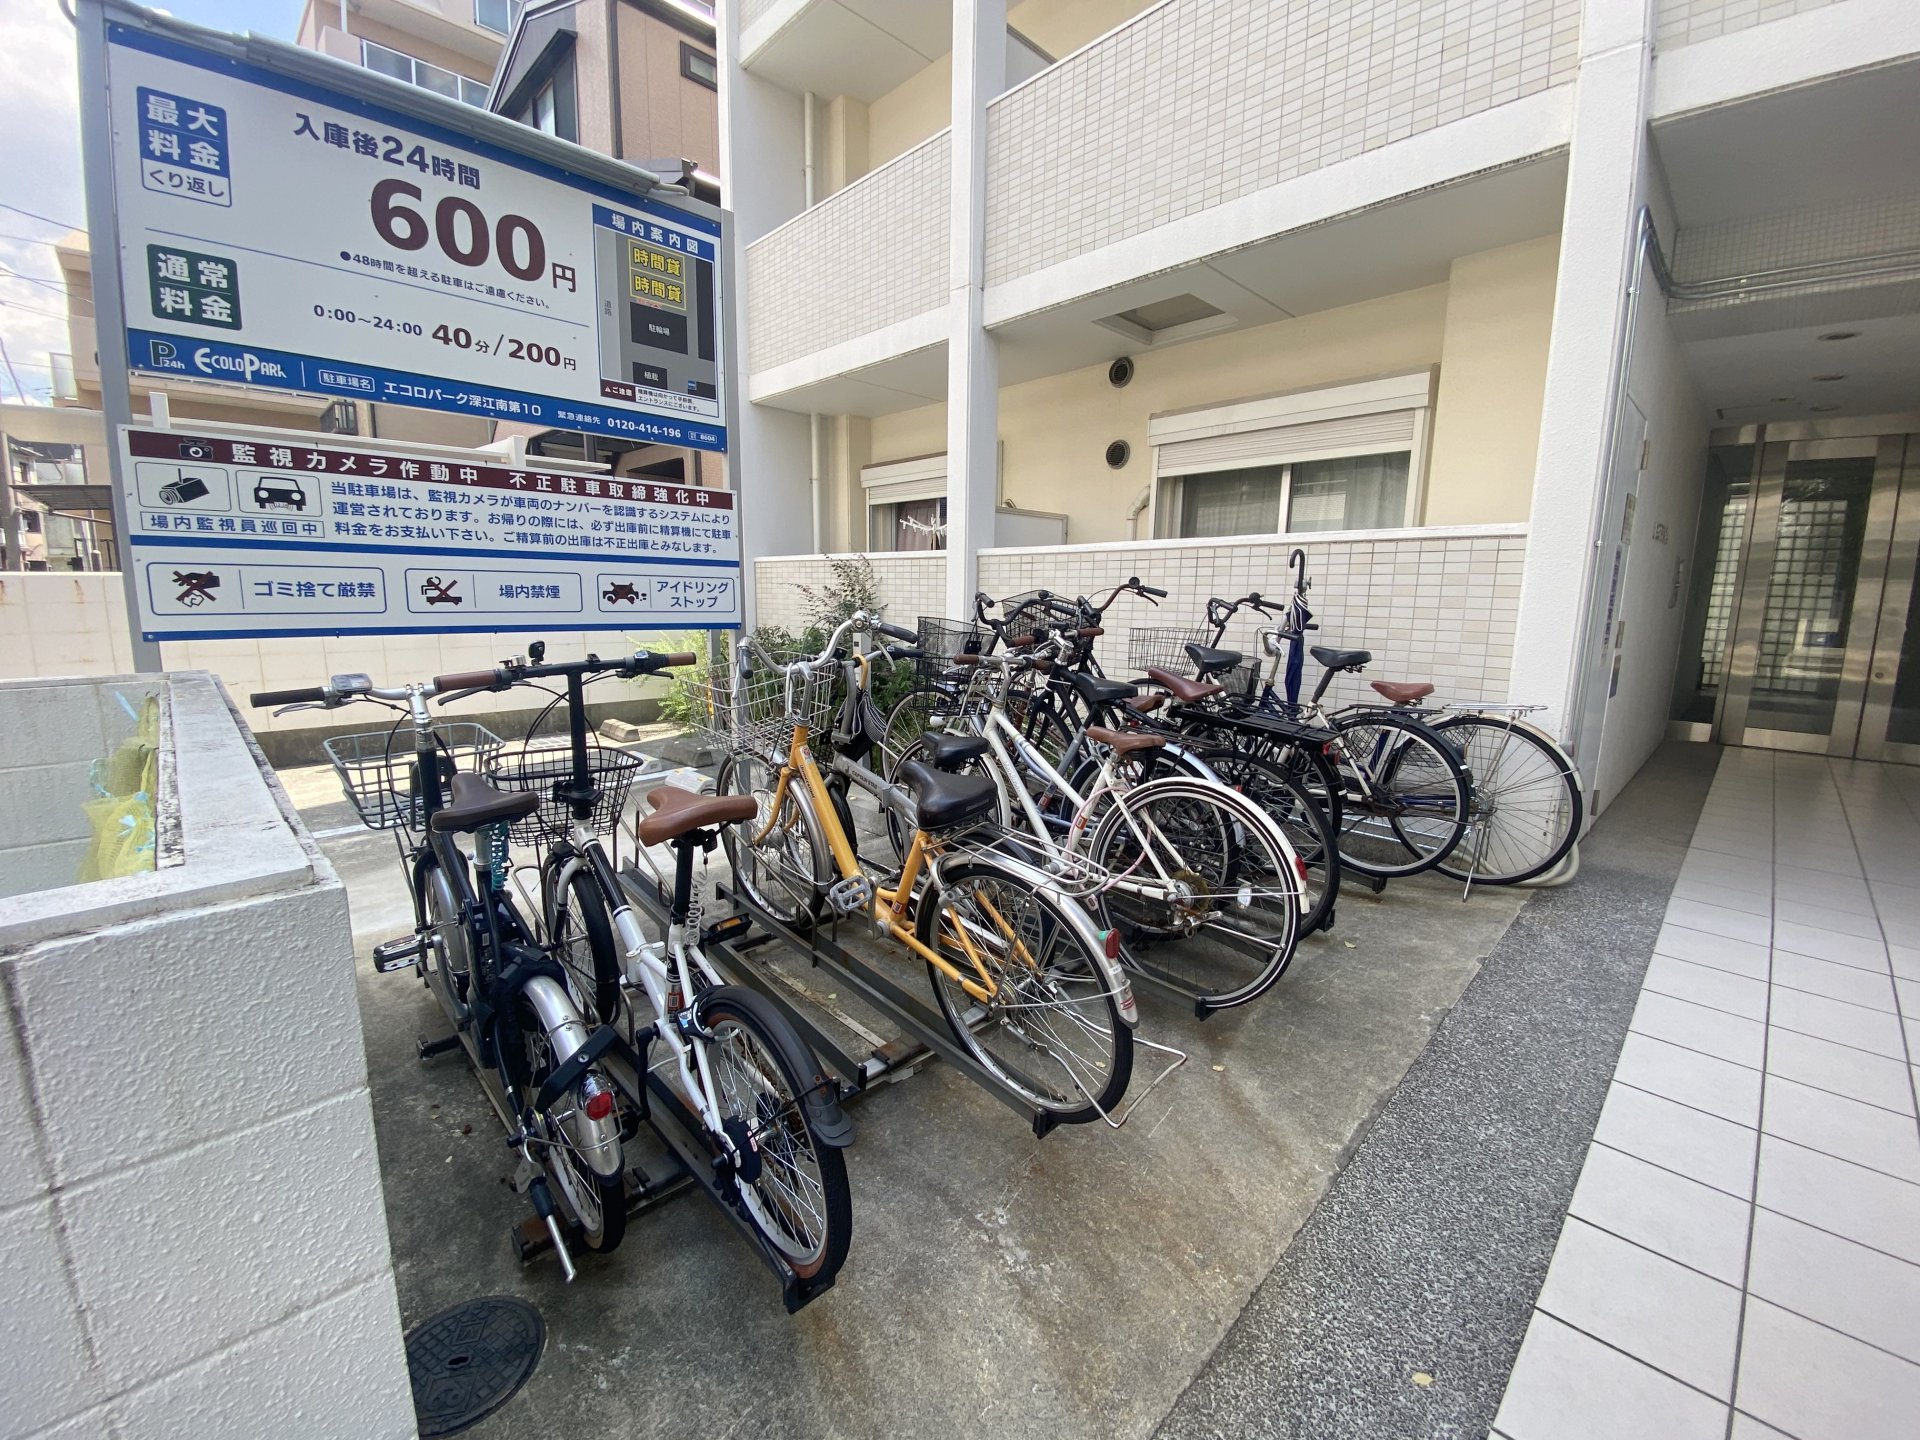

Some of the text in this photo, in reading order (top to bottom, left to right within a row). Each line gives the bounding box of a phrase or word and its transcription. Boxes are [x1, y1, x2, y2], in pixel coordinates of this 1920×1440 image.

[147, 94, 218, 136] 最大
[149, 129, 221, 171] 料金
[293, 112, 480, 190] 入庫後24時間
[150, 169, 224, 198] くり返し
[370, 179, 577, 293] 600円
[611, 213, 698, 254] 場内案内図
[157, 252, 228, 289] 通常
[633, 247, 681, 277] 時間貸
[160, 286, 232, 323] 料金
[634, 275, 682, 303] 時間貸
[321, 371, 373, 390] 駐車場名
[384, 381, 542, 417] エコロパーク深江南第10
[557, 410, 601, 426] 緊急連絡先
[607, 417, 682, 439] 0120-414-196
[231, 442, 709, 506] 監視カメラ作動中 不正駐車取締強化中
[331, 481, 730, 525] 当駐車場は、監視カメラが車両のナンバーを認識するシステムにより
[150, 514, 318, 536] 場内監視員巡回中
[332, 502, 731, 540] 運営されております。お帰りの際には、必ず出庫前に精算機にて駐車
[334, 521, 718, 554] 料金をお支払い下さい。ご精算前の出庫は不正出庫とみなします。
[254, 581, 376, 598] ゴミ捨て厳禁
[499, 584, 561, 600] 場内禁煙
[656, 581, 729, 594] アイドリング
[670, 596, 719, 608] ストップ
